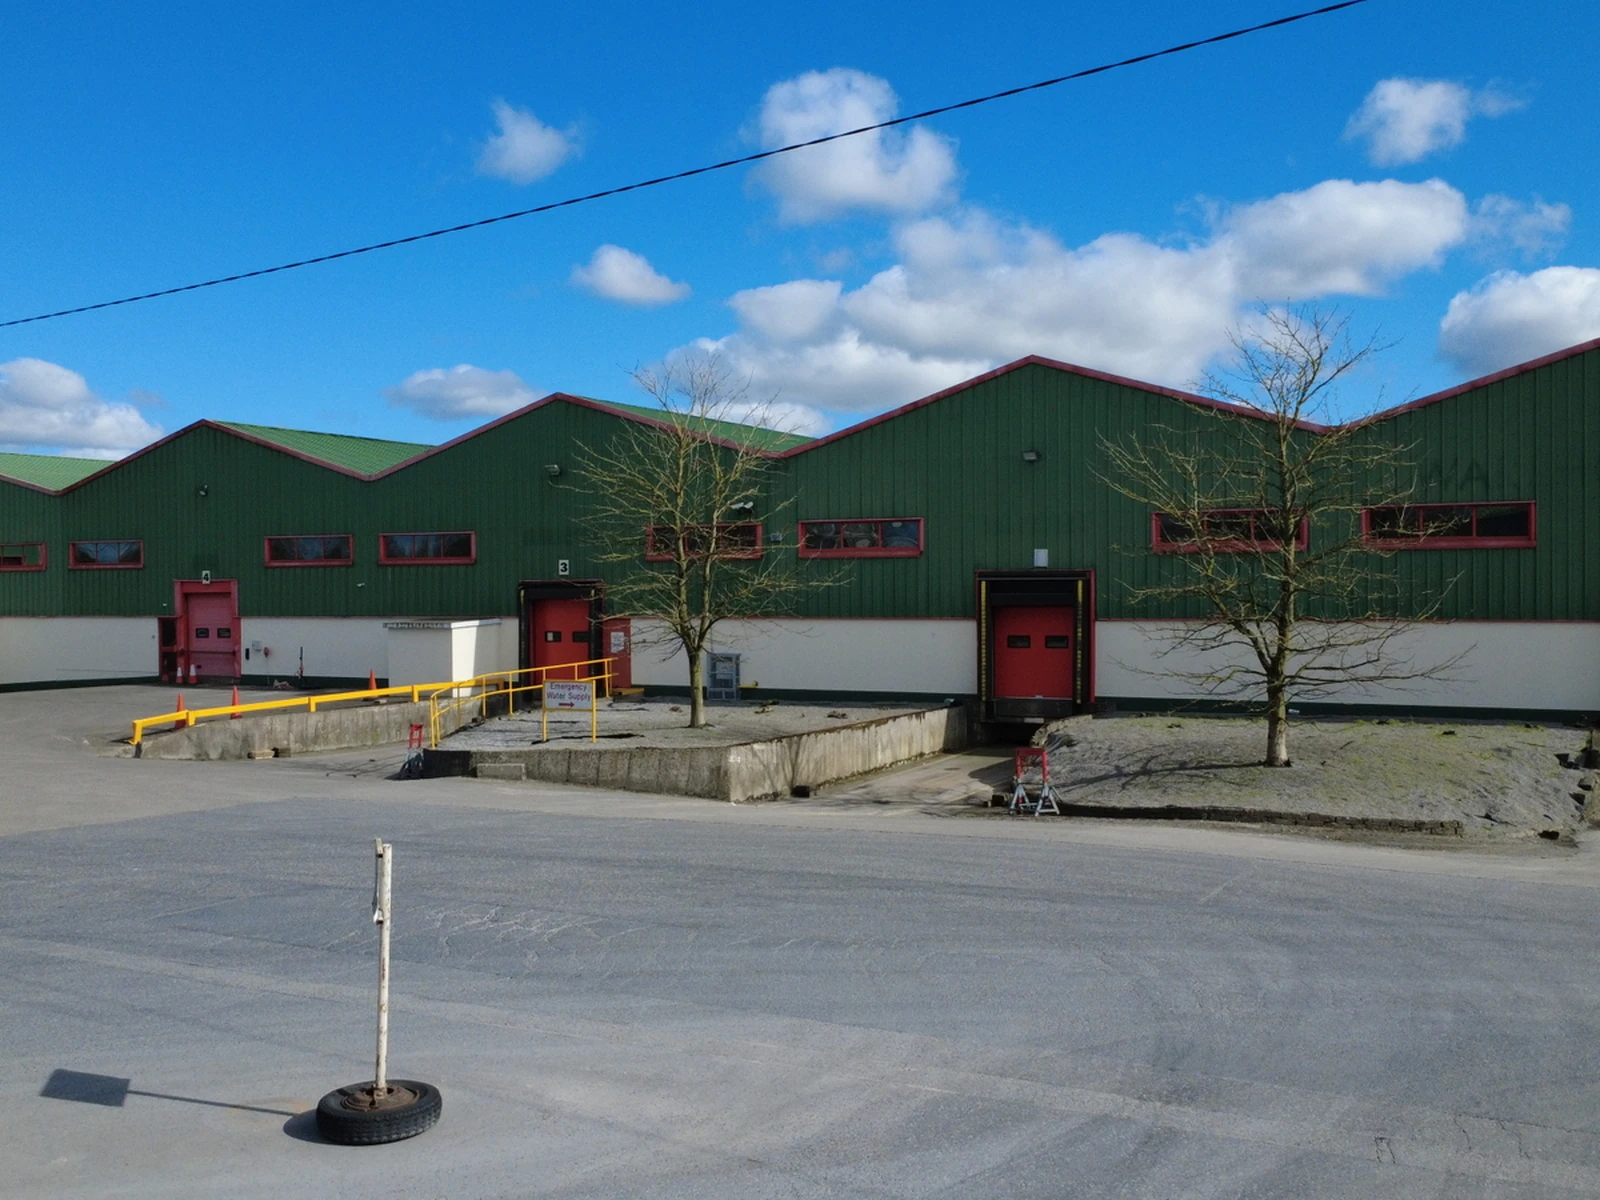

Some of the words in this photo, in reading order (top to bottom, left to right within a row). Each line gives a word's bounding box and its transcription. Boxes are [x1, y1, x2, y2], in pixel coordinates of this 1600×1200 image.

[560, 562, 568, 573] 3
[550, 682, 588, 691] Emergency
[547, 691, 566, 699] Water
[568, 691, 591, 701] Supply
